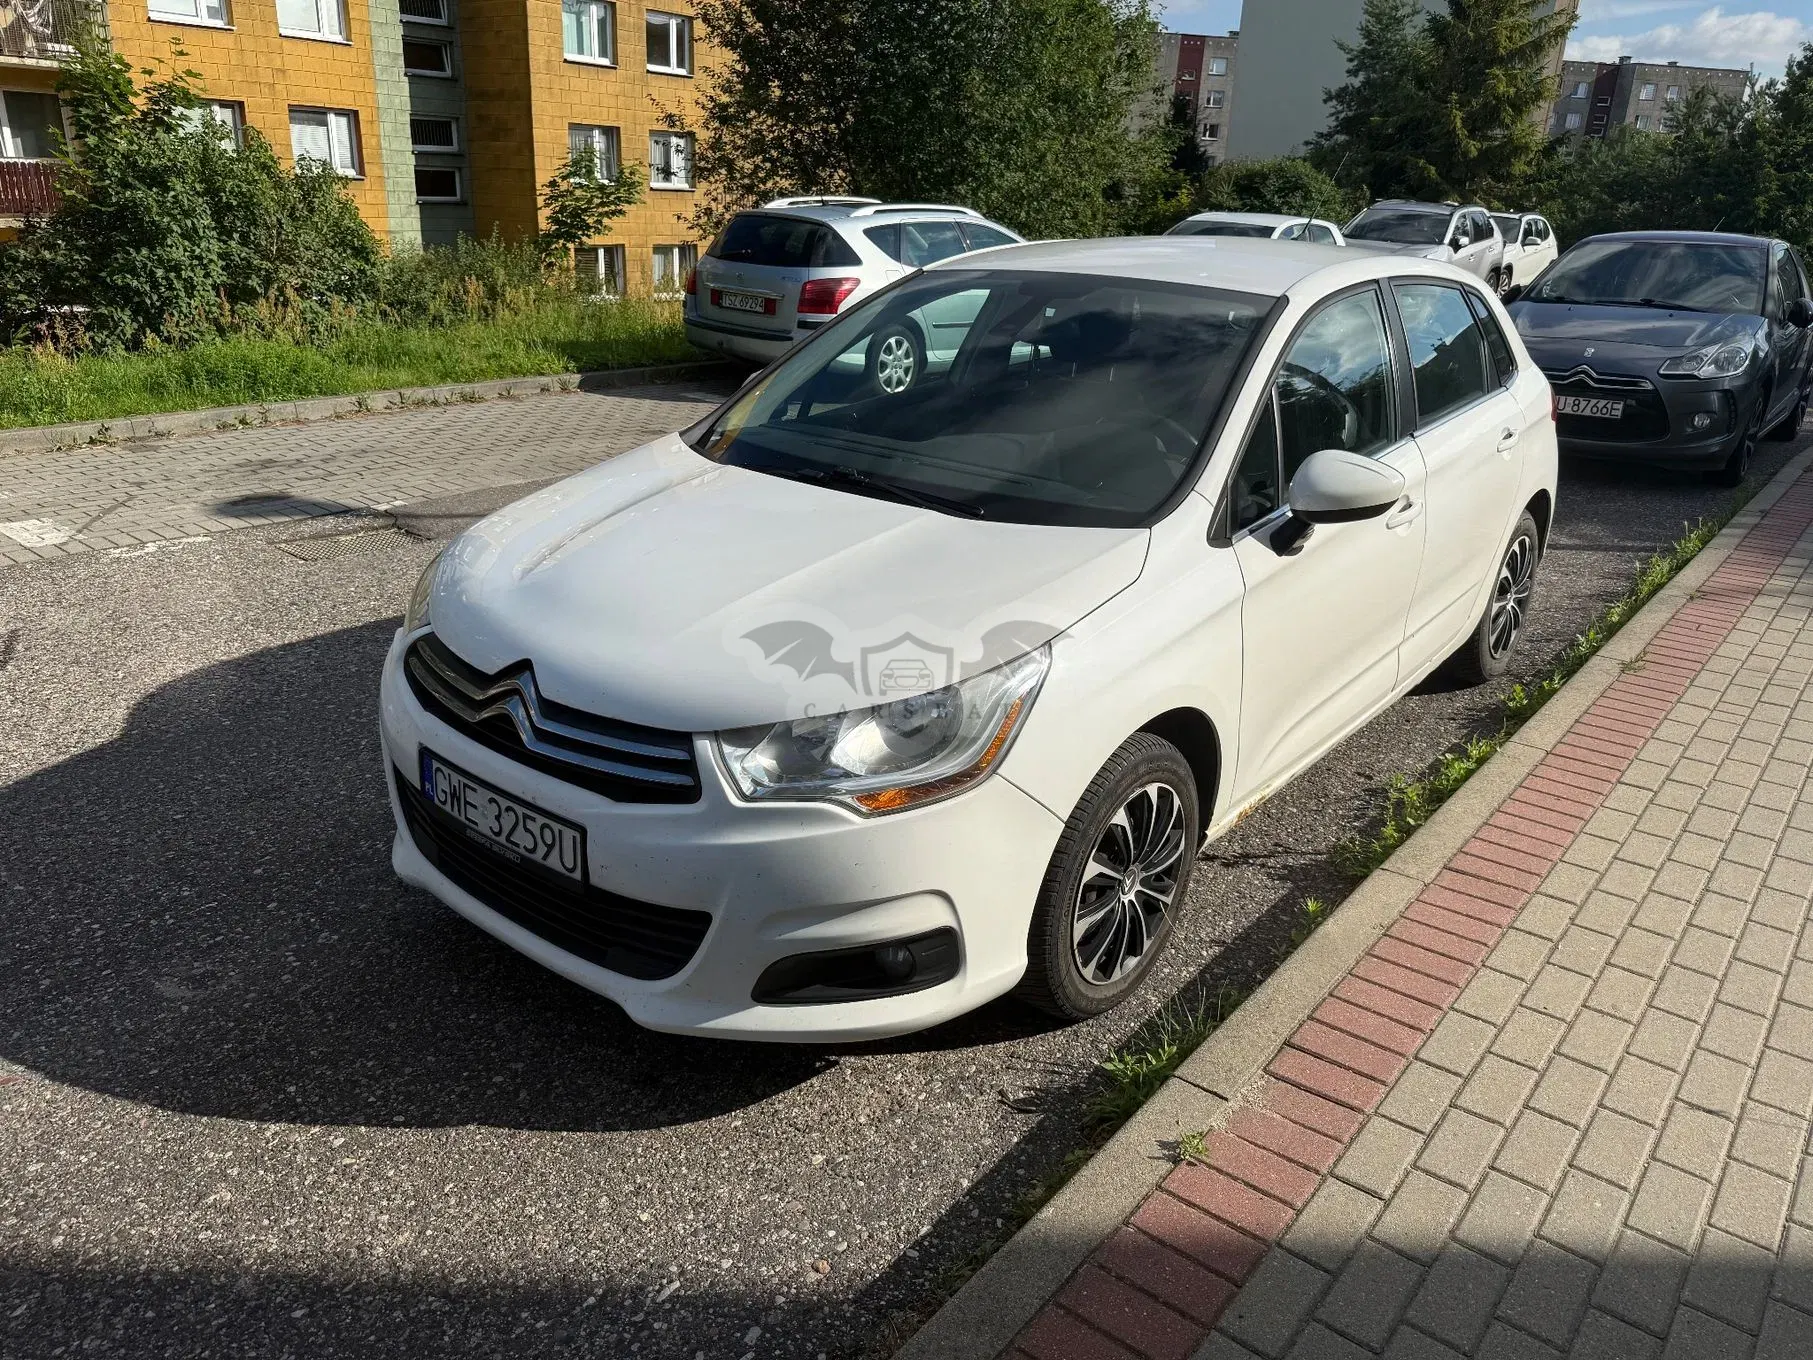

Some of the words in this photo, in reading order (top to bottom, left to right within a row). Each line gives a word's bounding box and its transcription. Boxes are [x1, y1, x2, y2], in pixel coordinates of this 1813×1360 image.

[723, 293, 738, 307] TSZ
[1571, 398, 1621, 417] 8766E
[435, 766, 479, 827] GWE
[487, 797, 578, 874] 3259U
